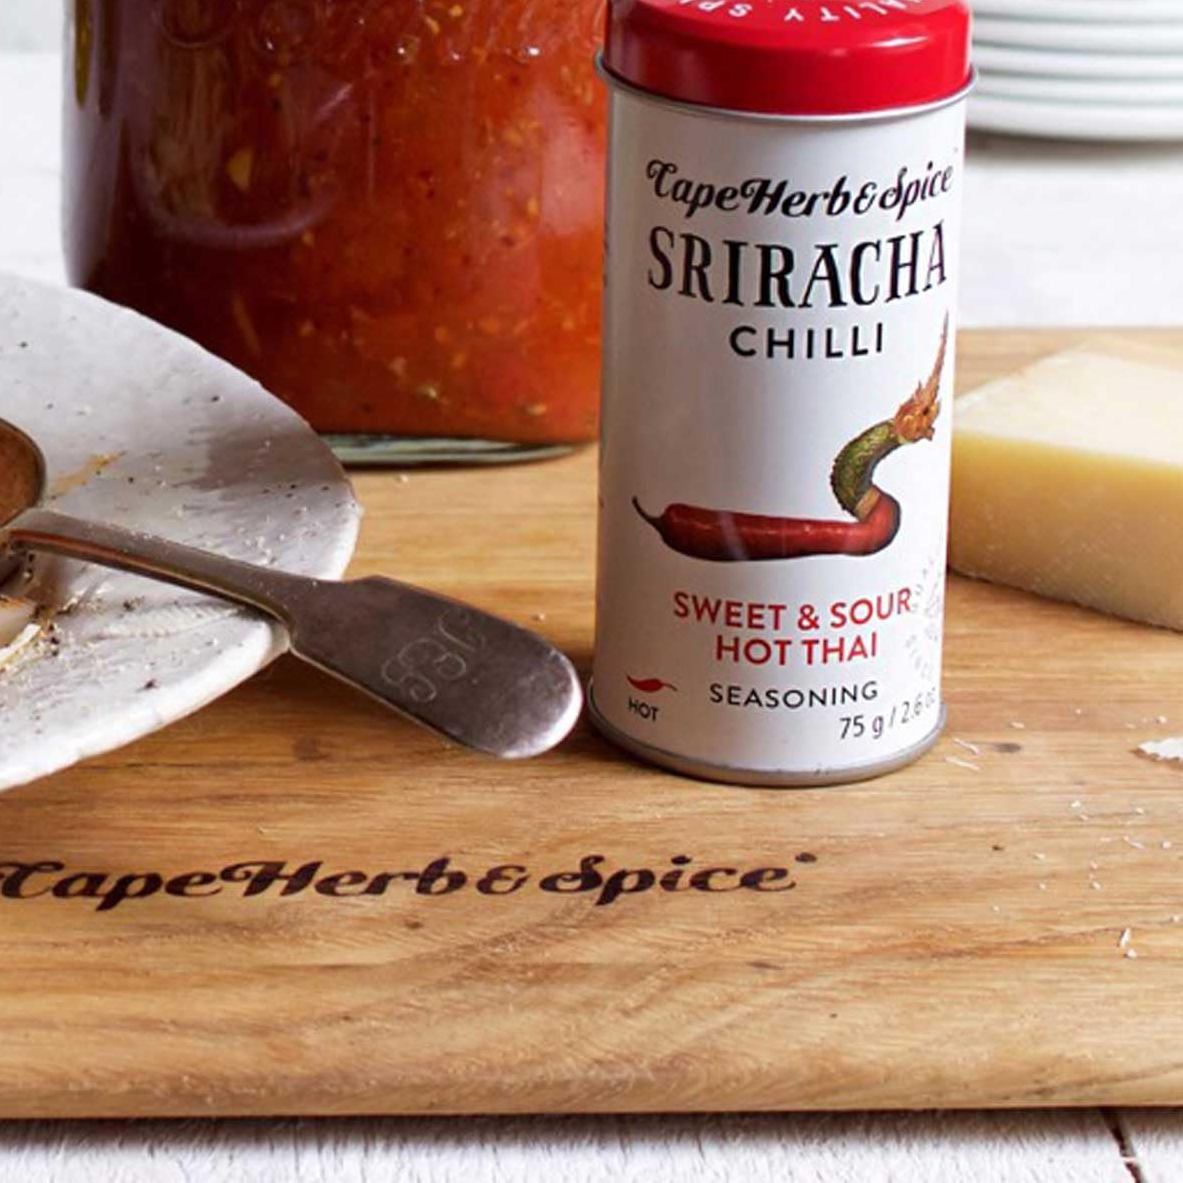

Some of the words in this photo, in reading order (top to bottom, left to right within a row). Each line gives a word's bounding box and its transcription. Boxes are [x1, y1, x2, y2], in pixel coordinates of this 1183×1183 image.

[648, 219, 947, 308] SRIRACHA
[729, 322, 883, 359] CHILLI
[674, 591, 787, 631] SWEET
[797, 604, 820, 630] &
[830, 587, 912, 629] SOUR
[716, 635, 792, 666] HOT
[802, 632, 878, 666] THAI
[628, 697, 660, 721] HOT
[710, 681, 879, 709] SEASONING
[839, 715, 866, 740] 75
[872, 715, 884, 740] g
